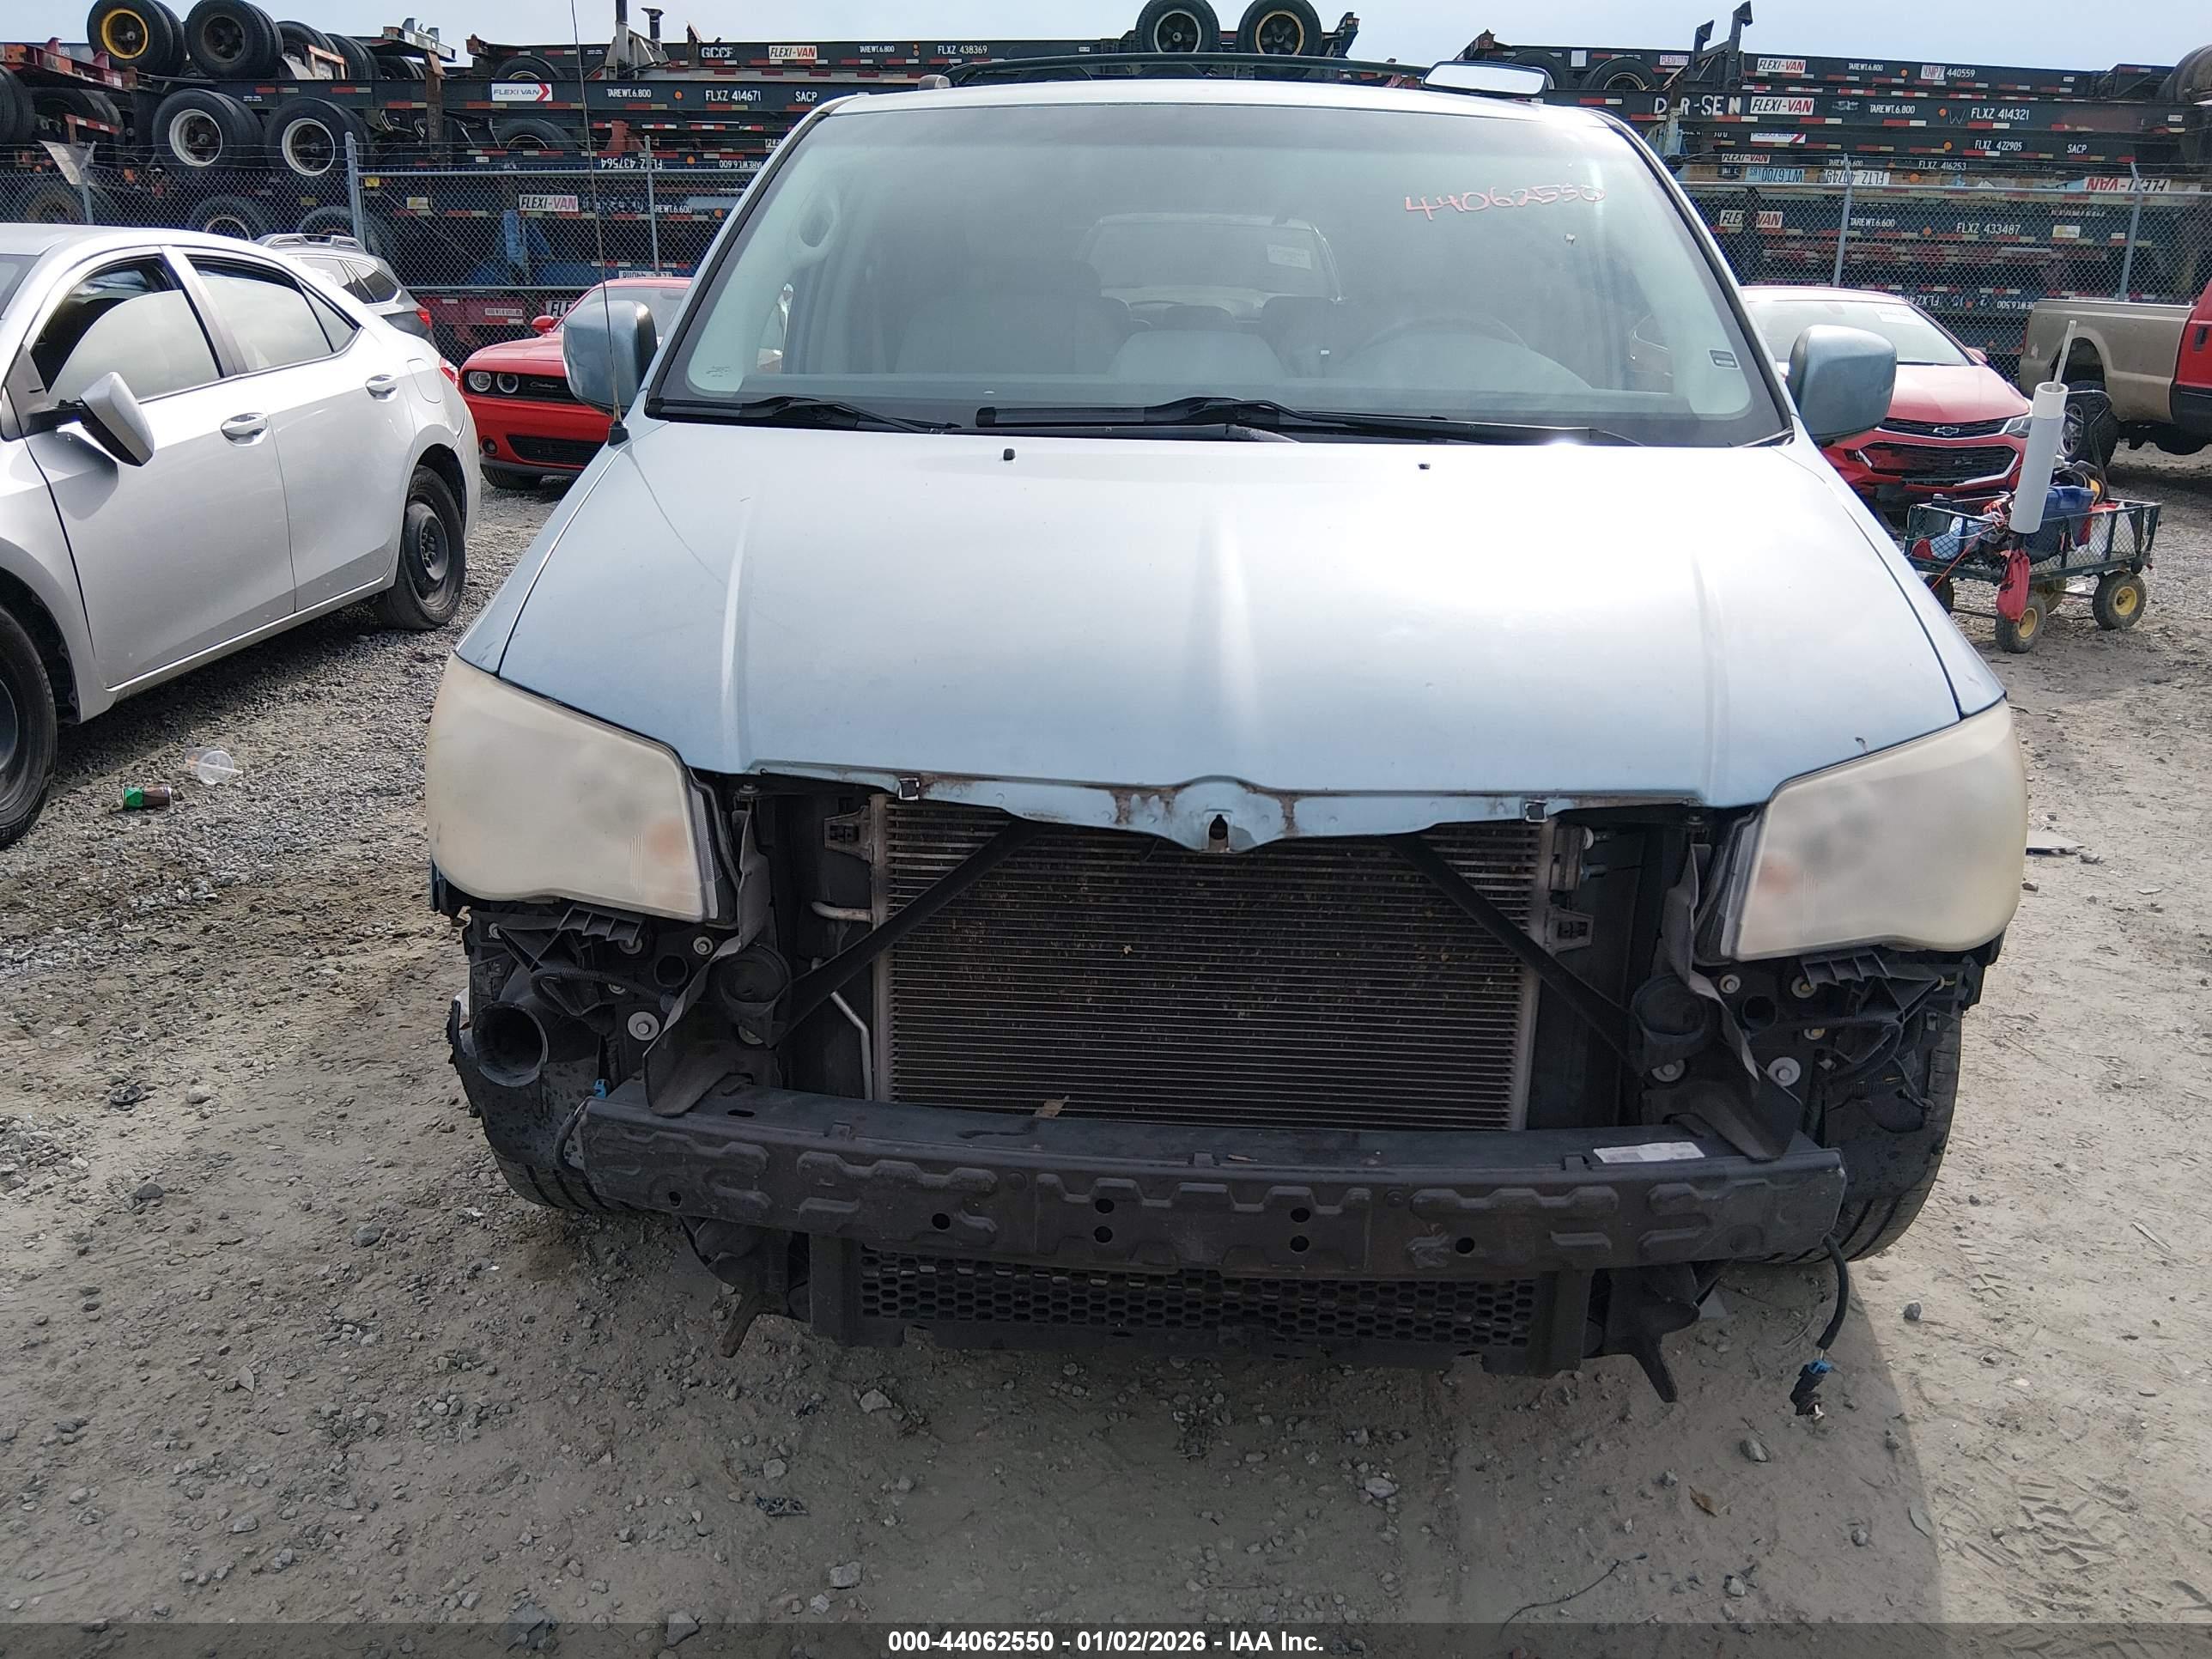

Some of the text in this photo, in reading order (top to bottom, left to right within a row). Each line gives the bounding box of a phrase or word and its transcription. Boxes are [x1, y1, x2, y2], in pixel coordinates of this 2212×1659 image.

[769, 47, 815, 58] FLEXI-VAN
[938, 45, 988, 54] FLXZ 438369
[1758, 59, 1804, 71] FLEXI-VAN
[1947, 68, 1975, 78] 440559
[705, 90, 761, 101] FLXZ 414671
[795, 91, 817, 102] SACP
[1752, 99, 1813, 112] FLEXI-VAN
[1971, 107, 2029, 120] FLXZ 414321
[1975, 140, 2022, 151] FLXZ 422905
[2067, 144, 2087, 154] SACP
[601, 157, 663, 170] FLZ 437564
[1918, 161, 1966, 171] FLXZ 416253
[1862, 172, 1885, 185] FLTZ
[520, 196, 576, 210] FLEXI-VAN
[1405, 183, 1607, 221] 44062550
[1956, 222, 2021, 234] FLXZ 433487
